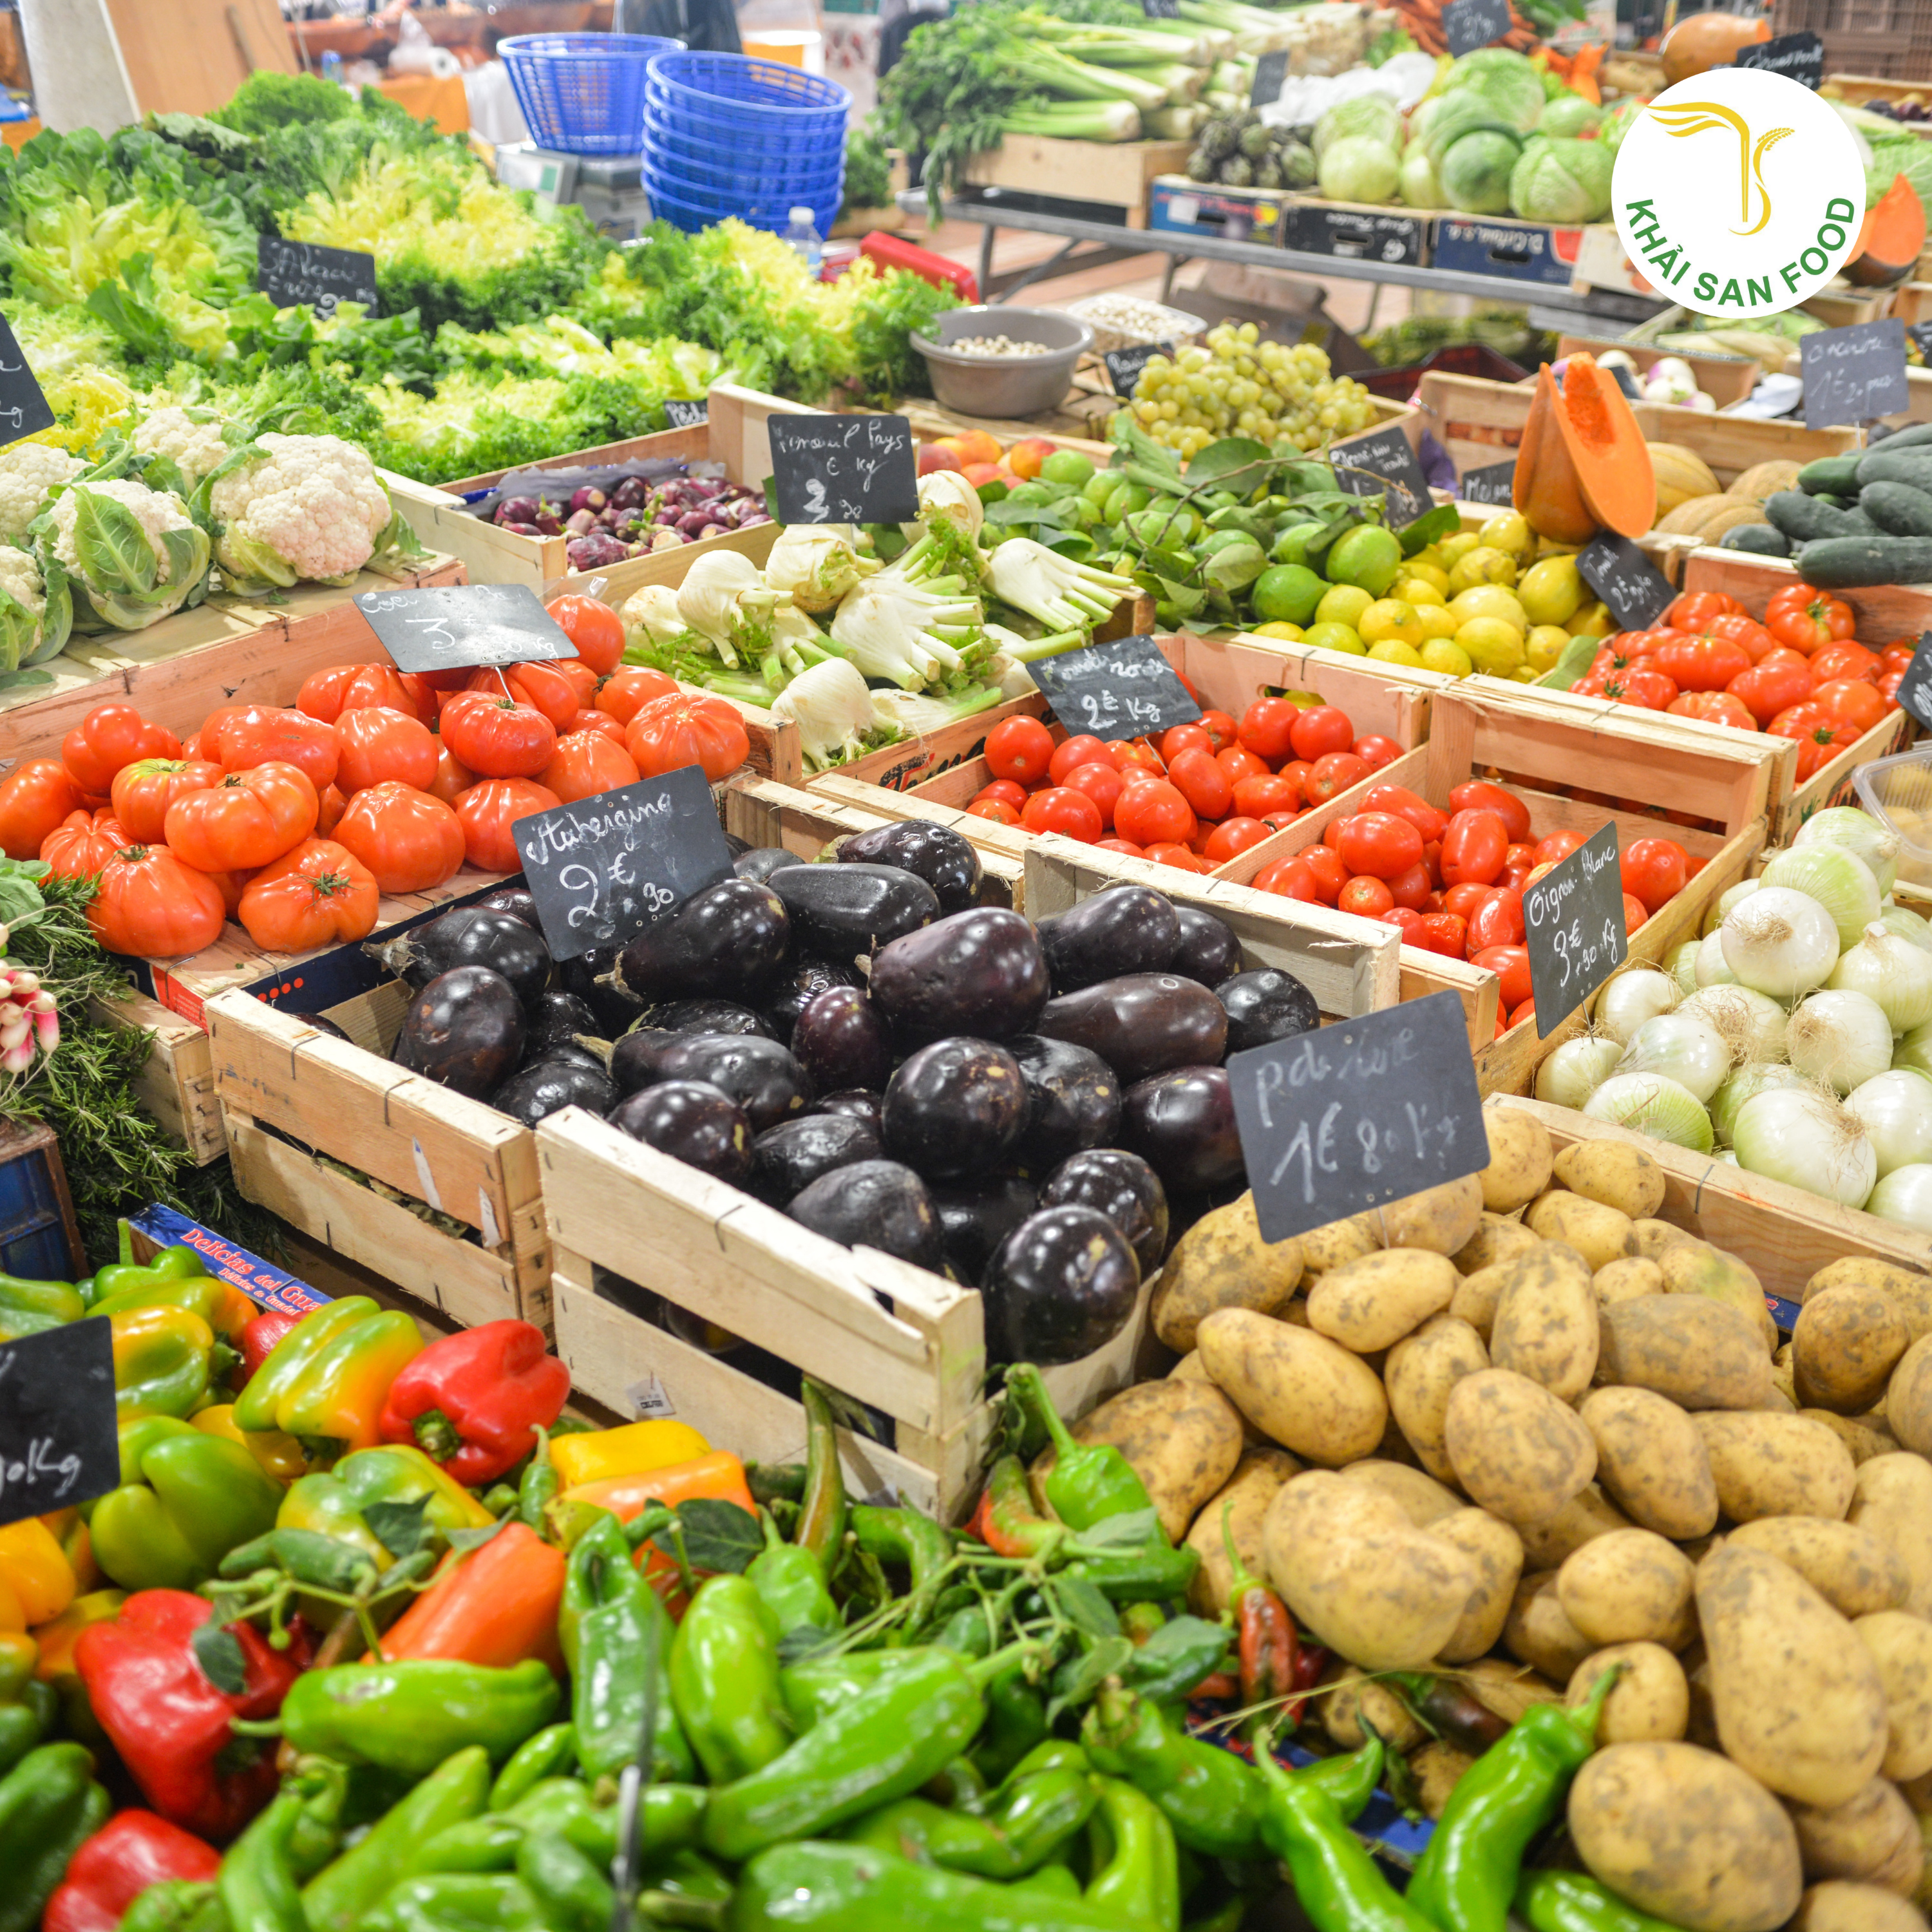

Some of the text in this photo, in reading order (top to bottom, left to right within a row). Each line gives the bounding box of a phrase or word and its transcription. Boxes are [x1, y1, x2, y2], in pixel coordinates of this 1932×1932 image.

[643, 882, 674, 913] 90
[179, 1227, 256, 1276] Delicias
[253, 1274, 283, 1292] del
